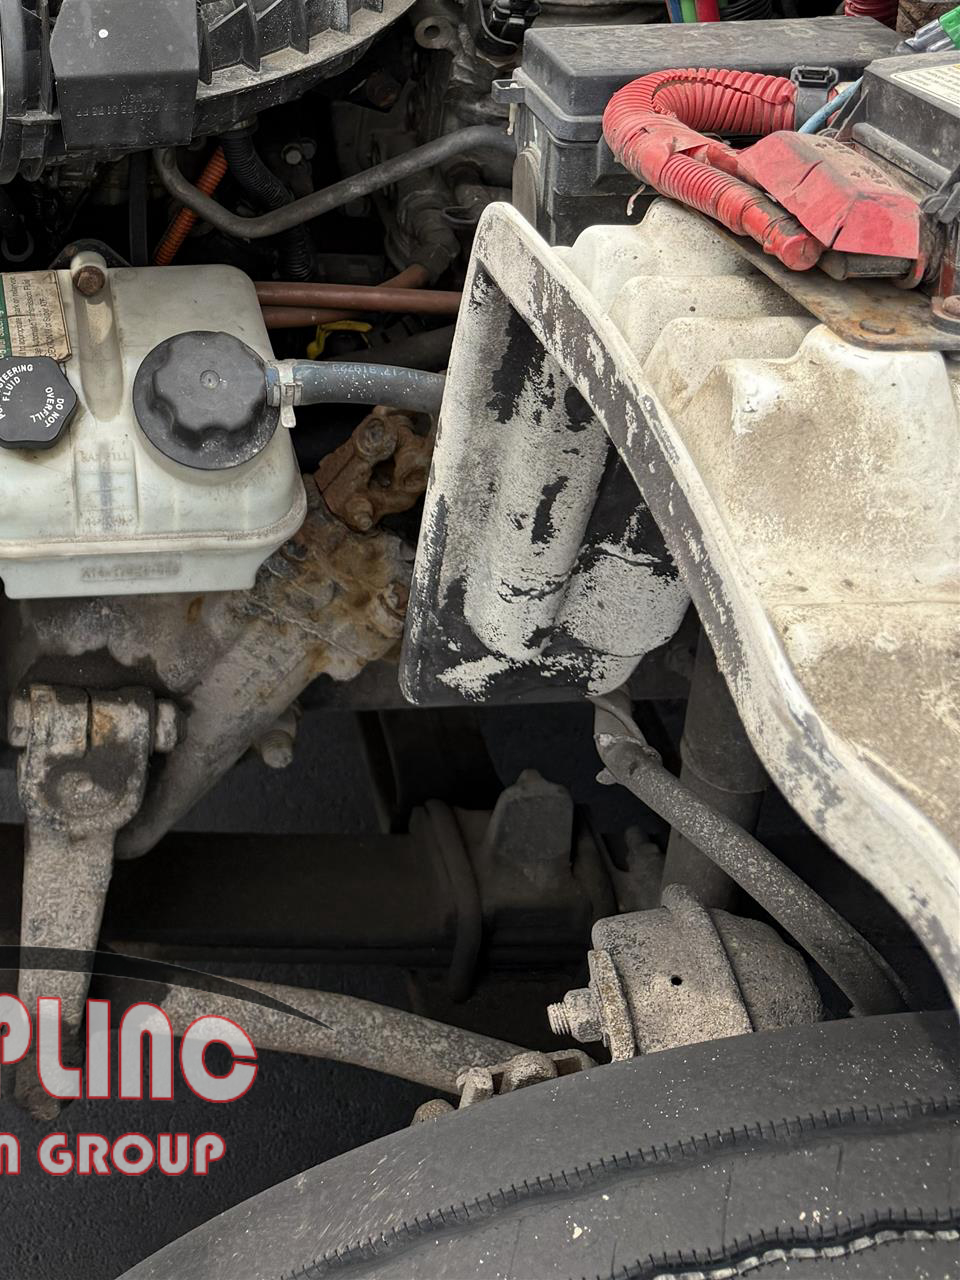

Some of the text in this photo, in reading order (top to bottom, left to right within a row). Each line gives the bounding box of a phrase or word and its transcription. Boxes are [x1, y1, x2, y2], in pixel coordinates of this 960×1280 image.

[2, 376, 21, 401] FLUID
[29, 386, 55, 422] OVERFILL
[44, 398, 65, 428] DO NOT
